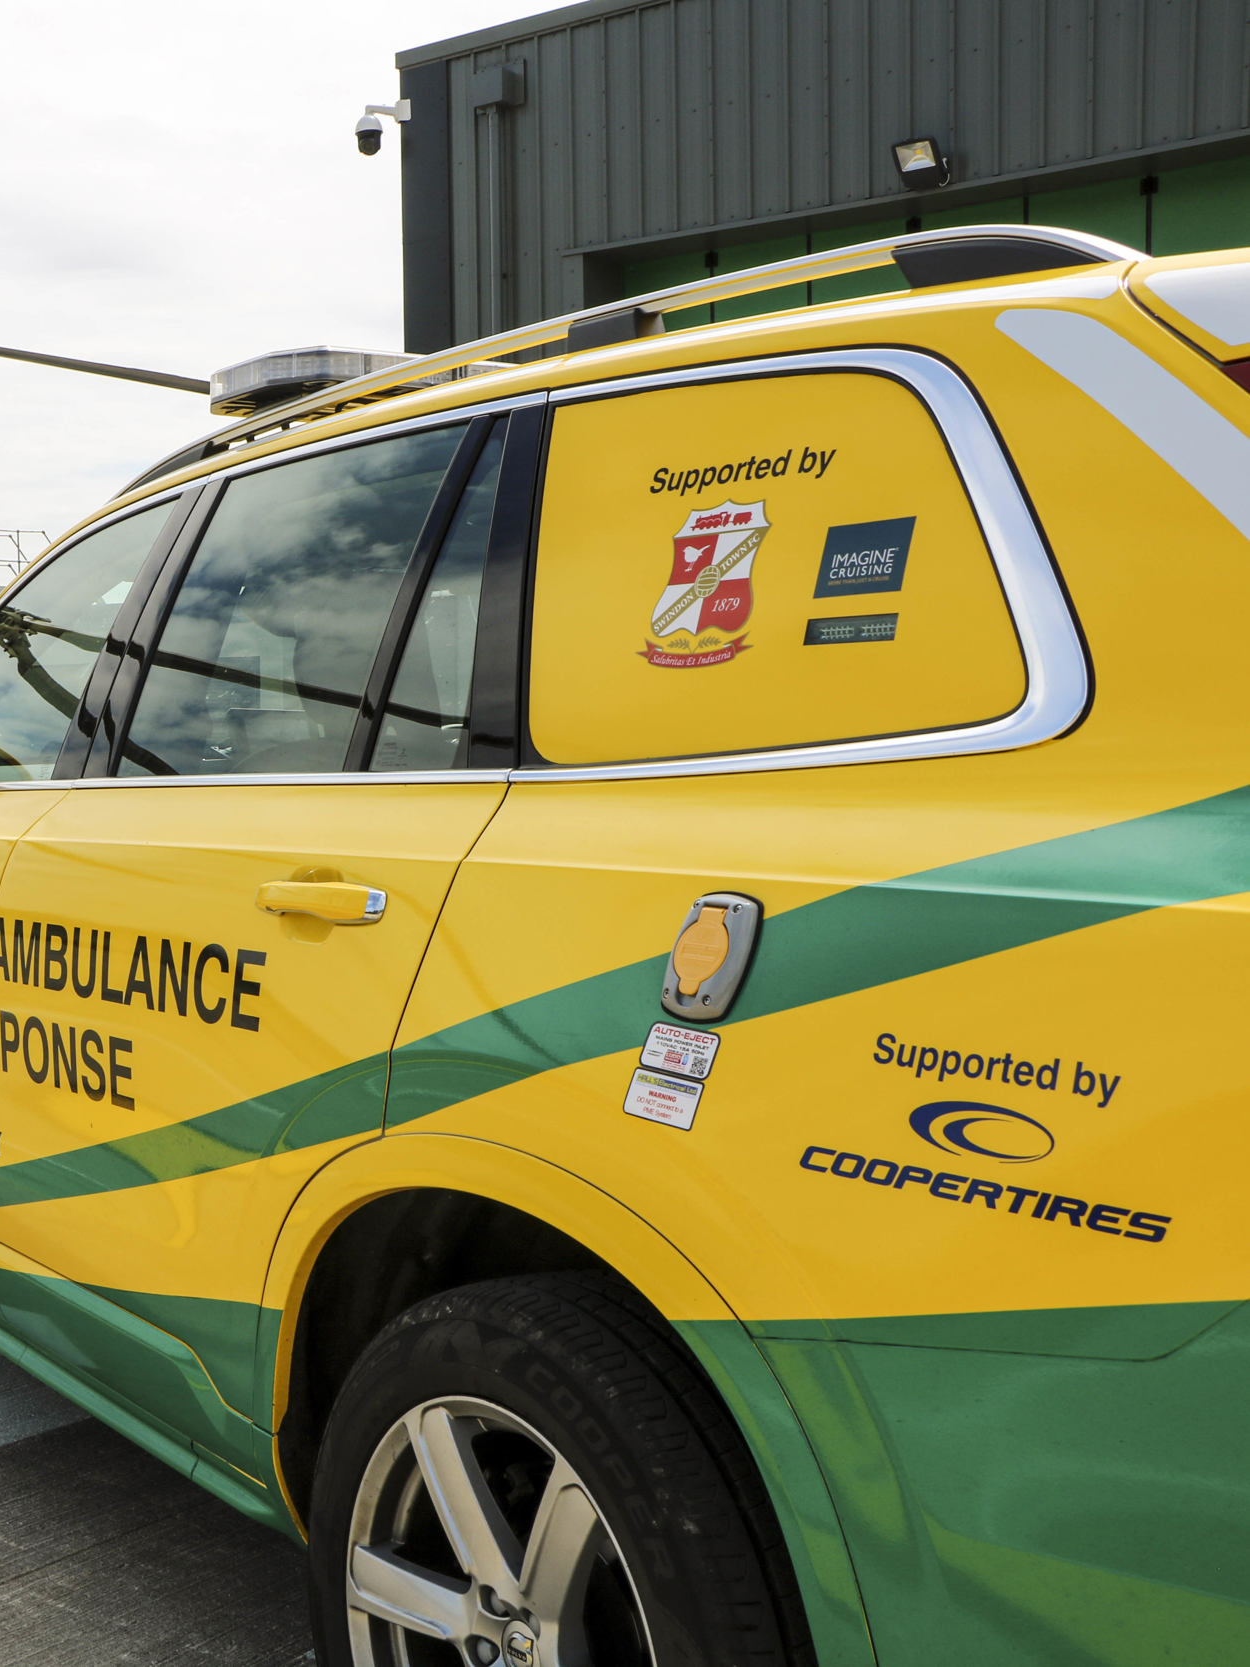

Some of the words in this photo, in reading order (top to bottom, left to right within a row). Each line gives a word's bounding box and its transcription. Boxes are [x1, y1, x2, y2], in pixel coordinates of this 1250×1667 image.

[649, 448, 792, 496] Supported
[798, 446, 836, 479] by
[831, 548, 895, 568] IMAGINE
[829, 564, 893, 579] CRUISING
[654, 592, 694, 633] SWINDON
[720, 544, 748, 572] TOWN
[747, 533, 761, 549] FC
[712, 598, 740, 612] 1879
[651, 654, 685, 666] Salubritas
[686, 656, 695, 666] Et
[698, 651, 731, 665] Industria
[653, 1026, 717, 1045] AUTO-EJECT
[673, 1039, 693, 1048] POWER
[873, 1032, 1060, 1090] Supported
[1072, 1062, 1121, 1108] by
[659, 1079, 686, 1092] Electrical
[687, 1086, 698, 1095] Ltd
[649, 1090, 677, 1102] WARNING
[646, 1098, 656, 1106] NOT
[656, 1102, 674, 1111] connect
[526, 1363, 676, 1579] COOPER
